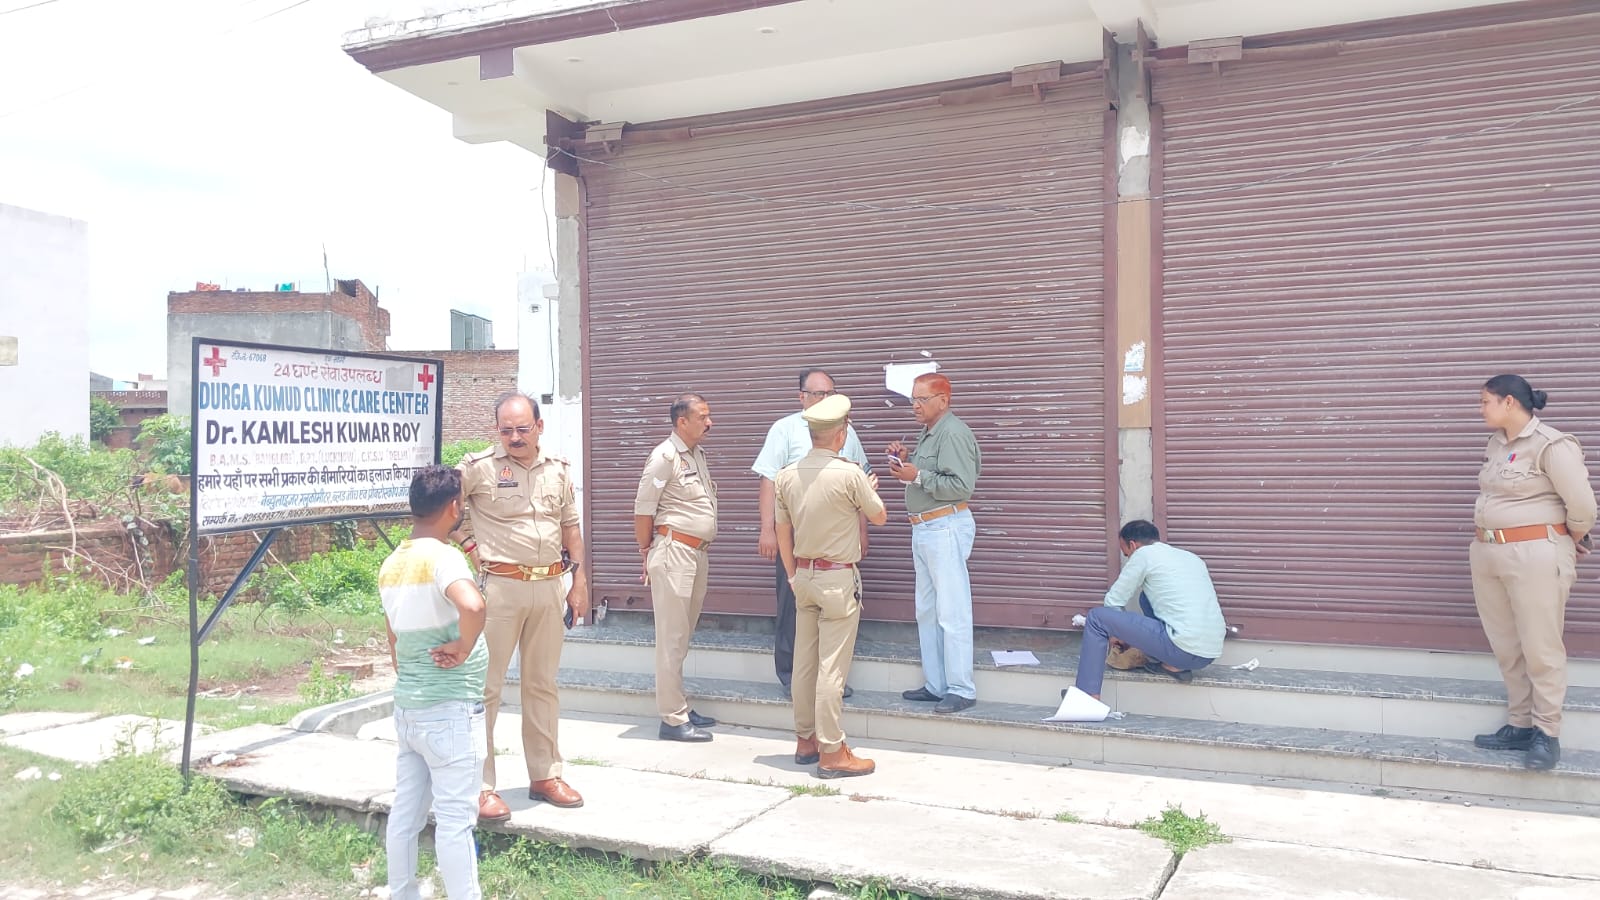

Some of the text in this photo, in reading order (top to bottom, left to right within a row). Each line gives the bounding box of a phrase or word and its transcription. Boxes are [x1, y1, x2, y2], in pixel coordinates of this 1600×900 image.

[274, 363, 290, 377] 24
[320, 363, 340, 382] सेवा
[341, 367, 383, 384] उपलब्ध
[200, 381, 429, 415] DURGA KUMUD CLINIC & CARE CENTER
[206, 419, 420, 444] Dr. KAMLESH KUMAR ROY
[198, 468, 222, 493] हमारे
[222, 467, 243, 491] यहाँ
[243, 472, 257, 488] पर
[258, 466, 280, 488] सभी
[280, 471, 307, 488] प्रकार
[307, 466, 320, 485] की
[320, 464, 357, 485] बीमारियों
[357, 469, 369, 483] का
[369, 467, 393, 485] इलाज
[393, 463, 411, 480] किया
